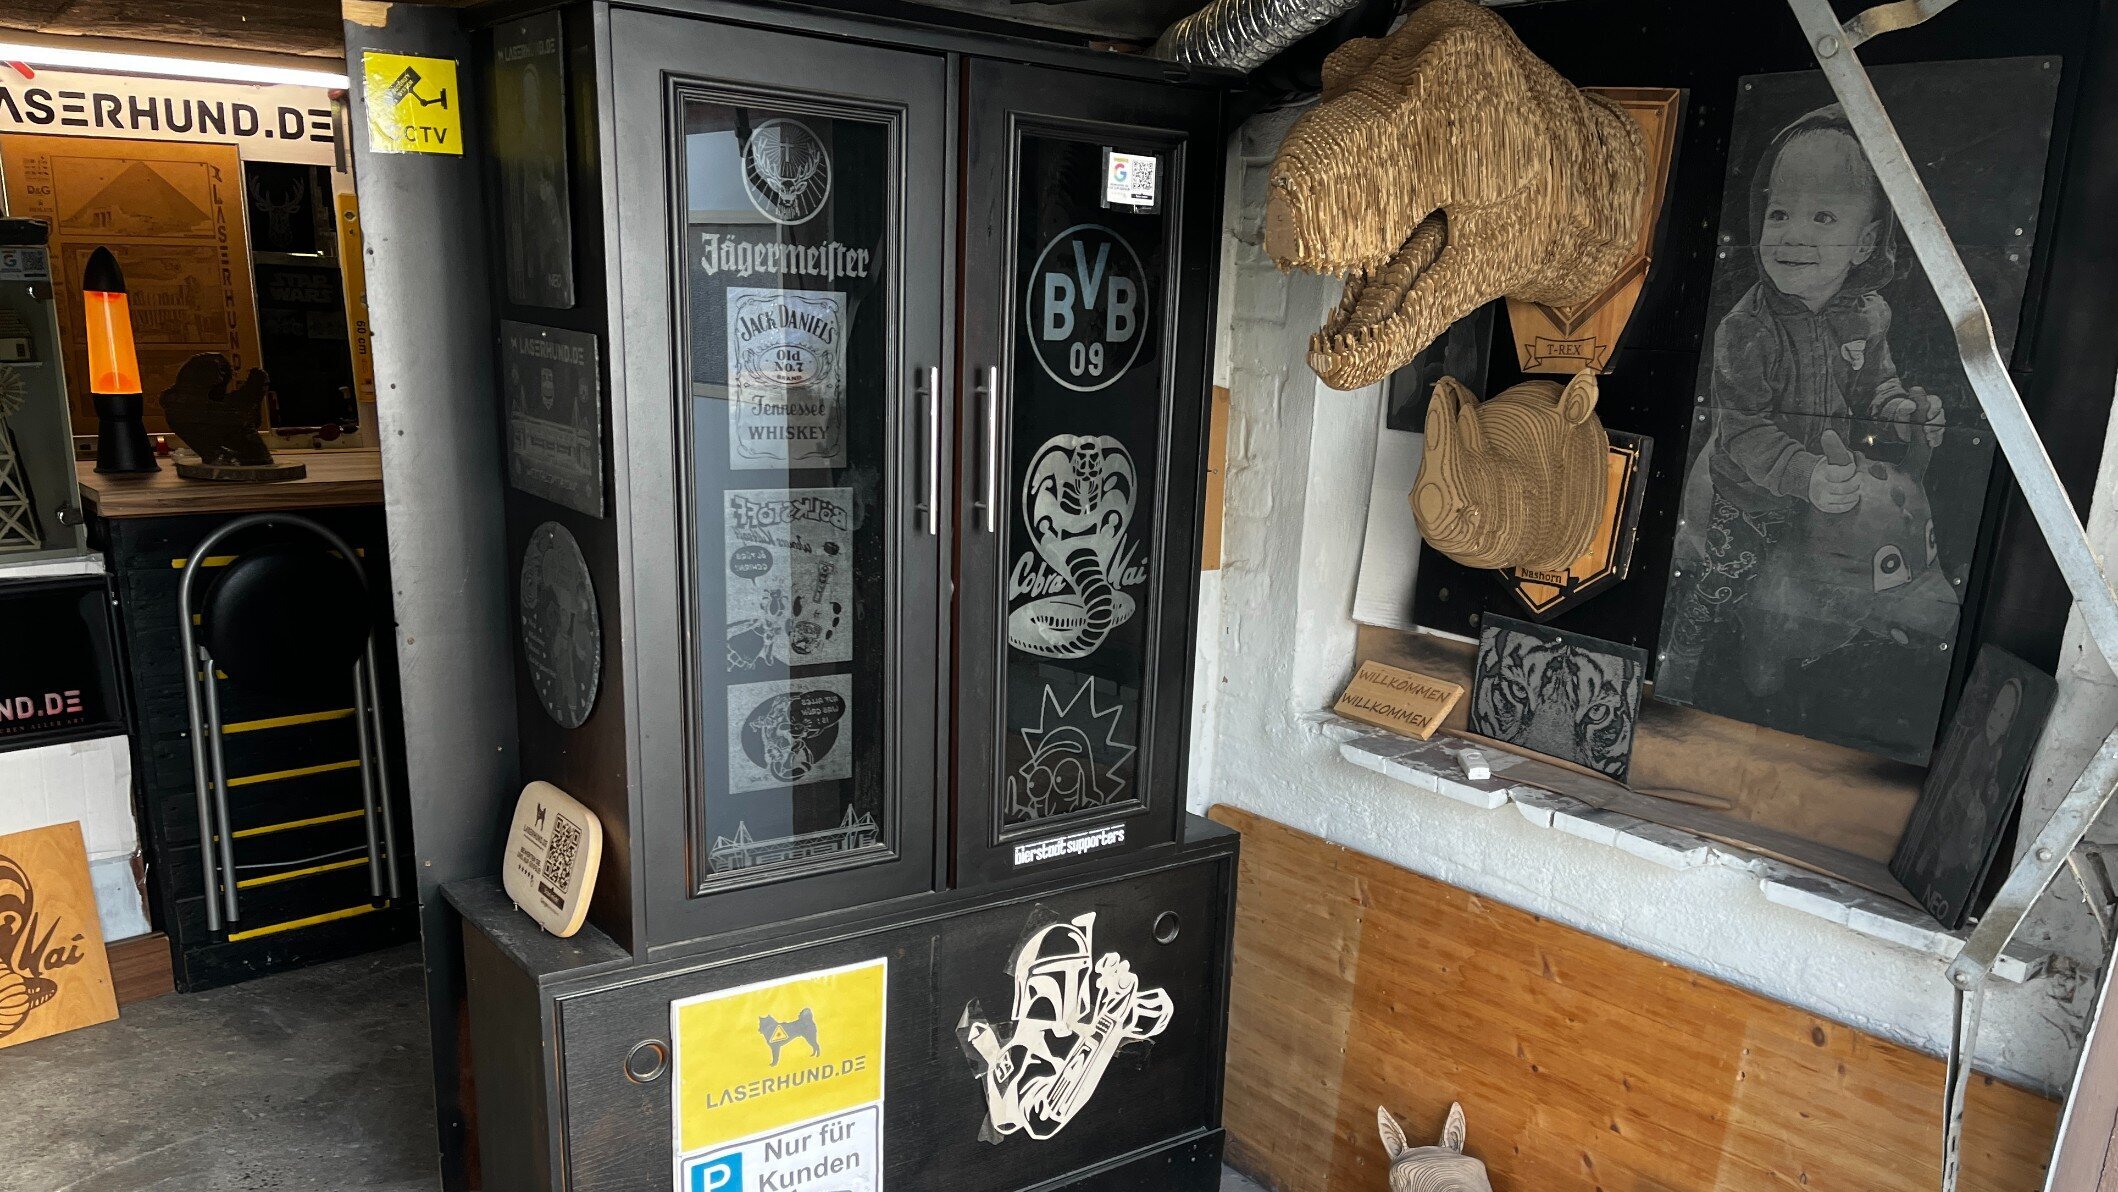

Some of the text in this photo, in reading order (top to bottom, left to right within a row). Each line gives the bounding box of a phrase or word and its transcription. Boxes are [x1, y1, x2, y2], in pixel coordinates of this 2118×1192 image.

[391, 124, 447, 144] CTV
[270, 287, 333, 304] WARS
[1043, 240, 1137, 342] BVB
[356, 320, 367, 334] 60
[739, 304, 837, 344] JACK DANIEL'S
[358, 338, 367, 355] cm
[519, 338, 585, 366] LASERHUND.DE
[776, 349, 800, 361] Old
[1070, 342, 1104, 377] 09
[1546, 343, 1582, 357] T-REX
[752, 395, 826, 416] Tennessee
[748, 426, 830, 440] WHISKEY
[1009, 533, 1148, 602] Cobra Kai
[1521, 567, 1562, 584] Nashorn
[1359, 669, 1451, 703] WILLKOMMEN
[1341, 692, 1433, 728] WILLKOMMEN
[1923, 884, 1949, 921] NEO
[18, 912, 86, 974] Kai
[706, 1055, 866, 1109] LASERHUND.DE
[764, 1120, 856, 1163] Nur für
[759, 1151, 860, 1192] Kunden
